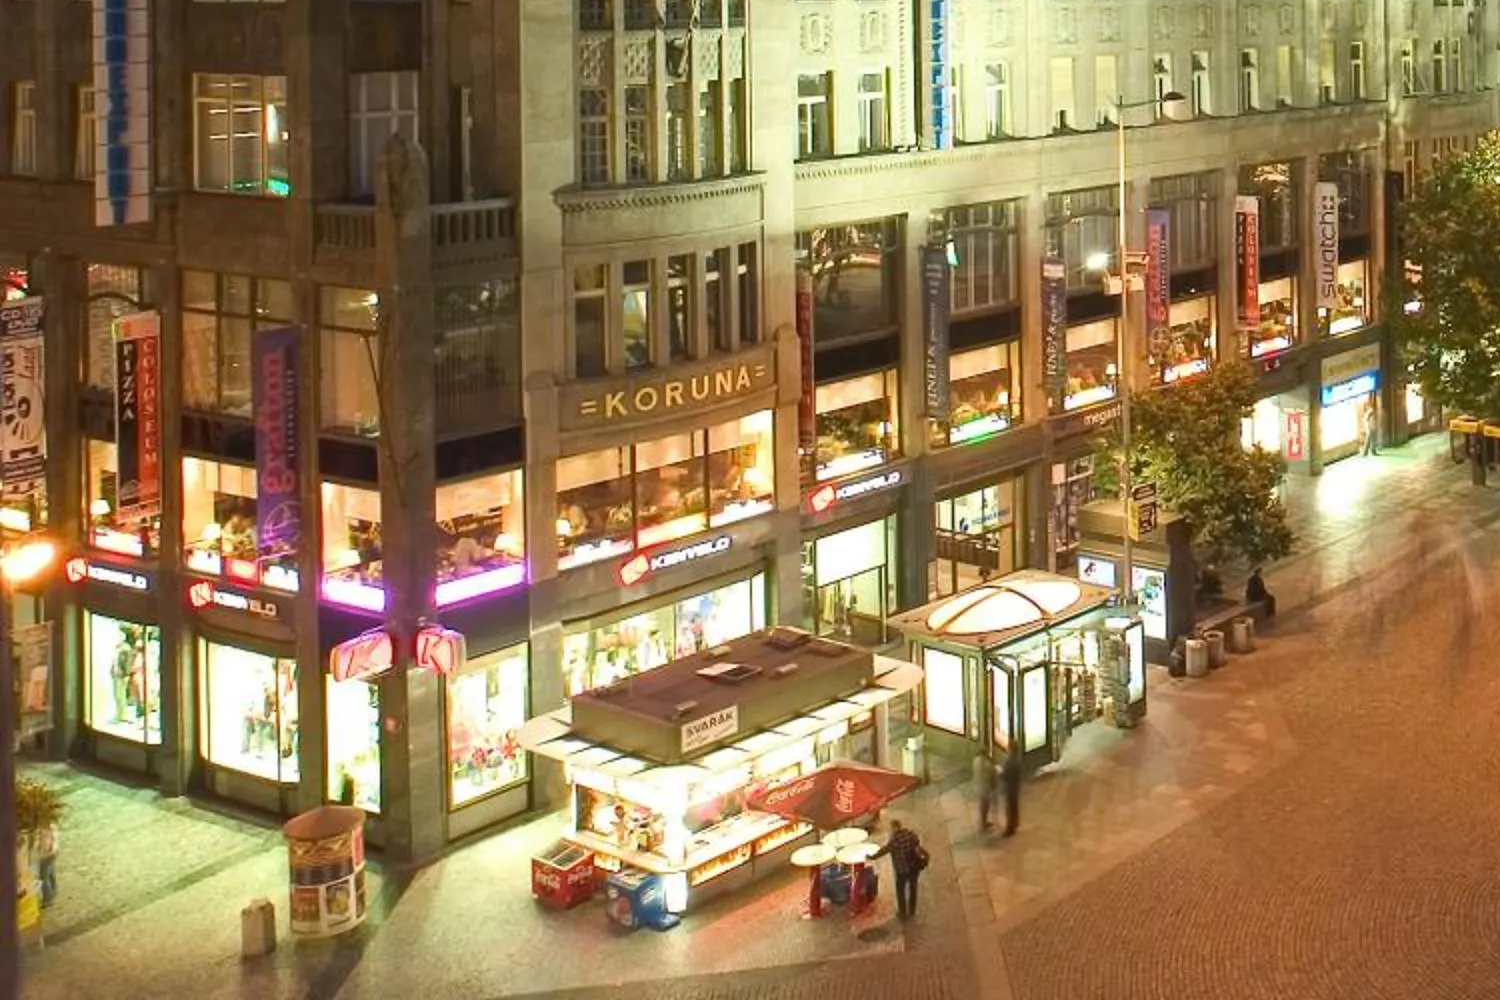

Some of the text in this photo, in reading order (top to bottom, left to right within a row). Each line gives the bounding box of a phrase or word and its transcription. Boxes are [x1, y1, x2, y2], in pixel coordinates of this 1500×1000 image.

[1320, 211, 1337, 299] swatch
[122, 343, 135, 420] PIZZA
[605, 366, 751, 418] KORUNA
